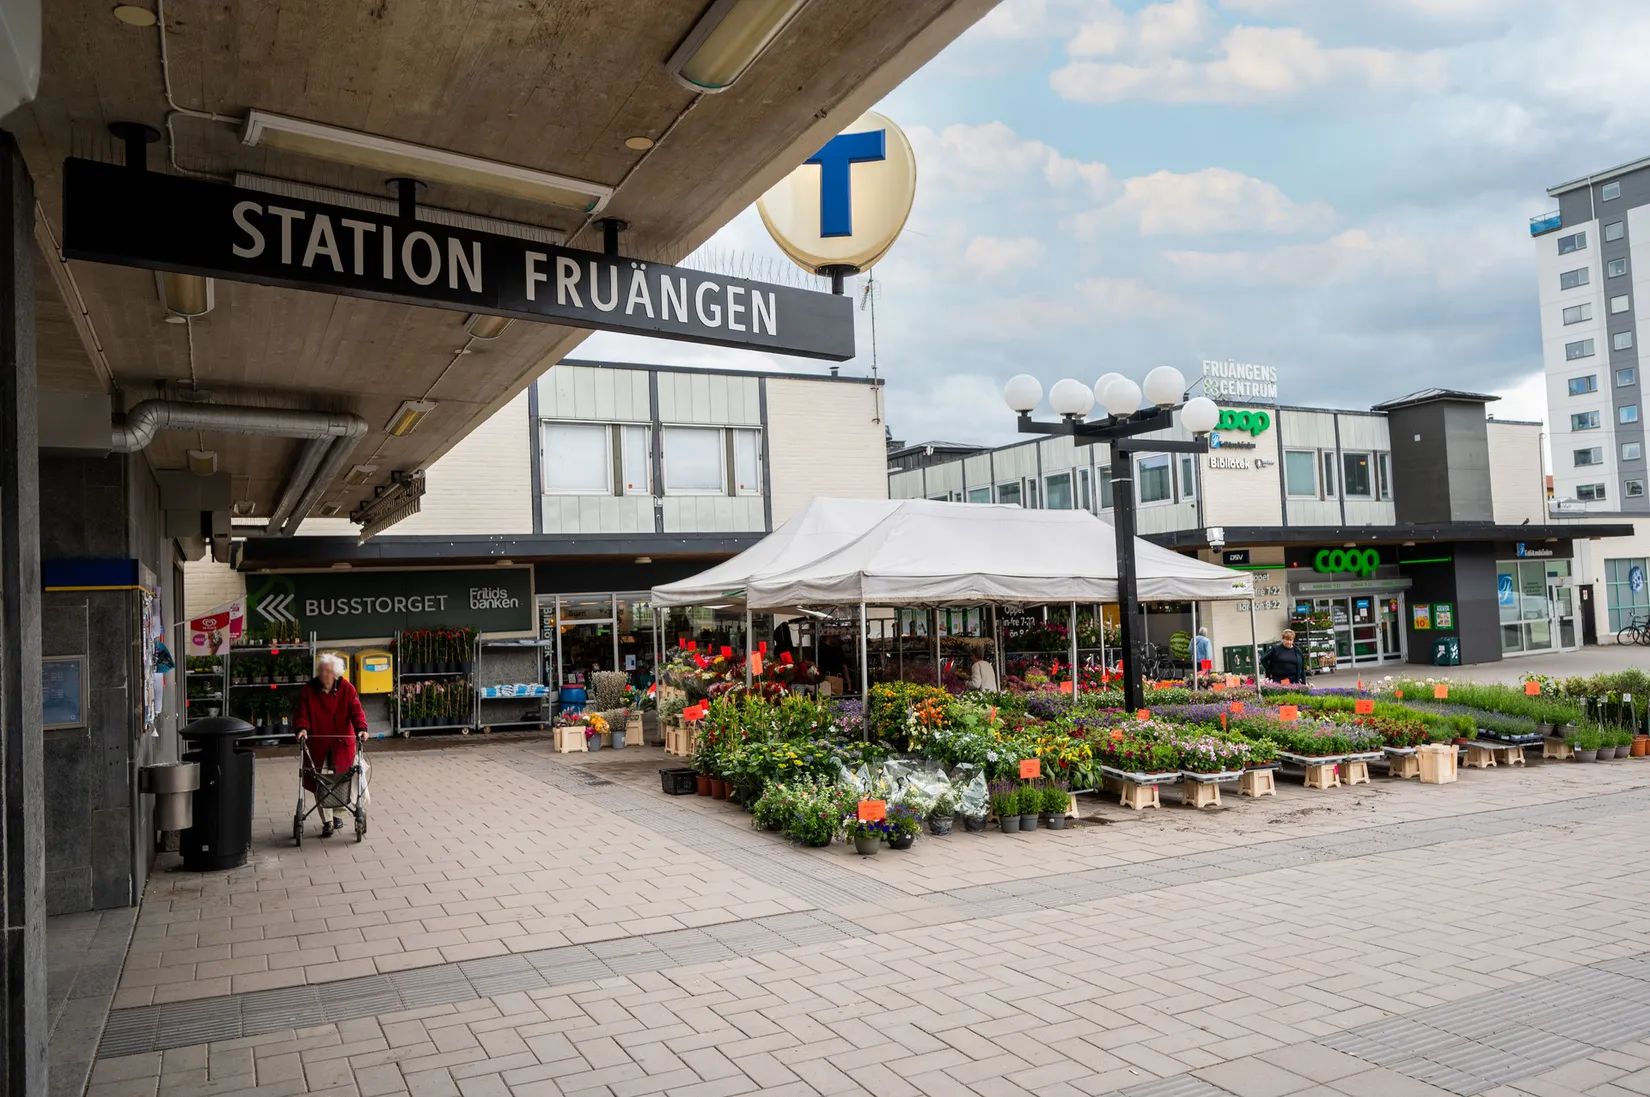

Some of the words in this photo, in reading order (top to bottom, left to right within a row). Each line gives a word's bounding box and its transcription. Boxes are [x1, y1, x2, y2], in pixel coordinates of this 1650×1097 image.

[802, 129, 886, 238] T
[232, 201, 482, 293] STATION
[525, 250, 777, 336] FRUÄNGEN
[1202, 359, 1277, 382] FRUÄNGENS
[1220, 380, 1277, 398] CENTRUM
[1210, 457, 1251, 469] Bibliotek
[1313, 548, 1381, 577] coop
[1252, 573, 1270, 583] ppet
[469, 587, 508, 600] Fritids
[469, 597, 519, 609] banken
[305, 594, 448, 617] BUSSTORGET
